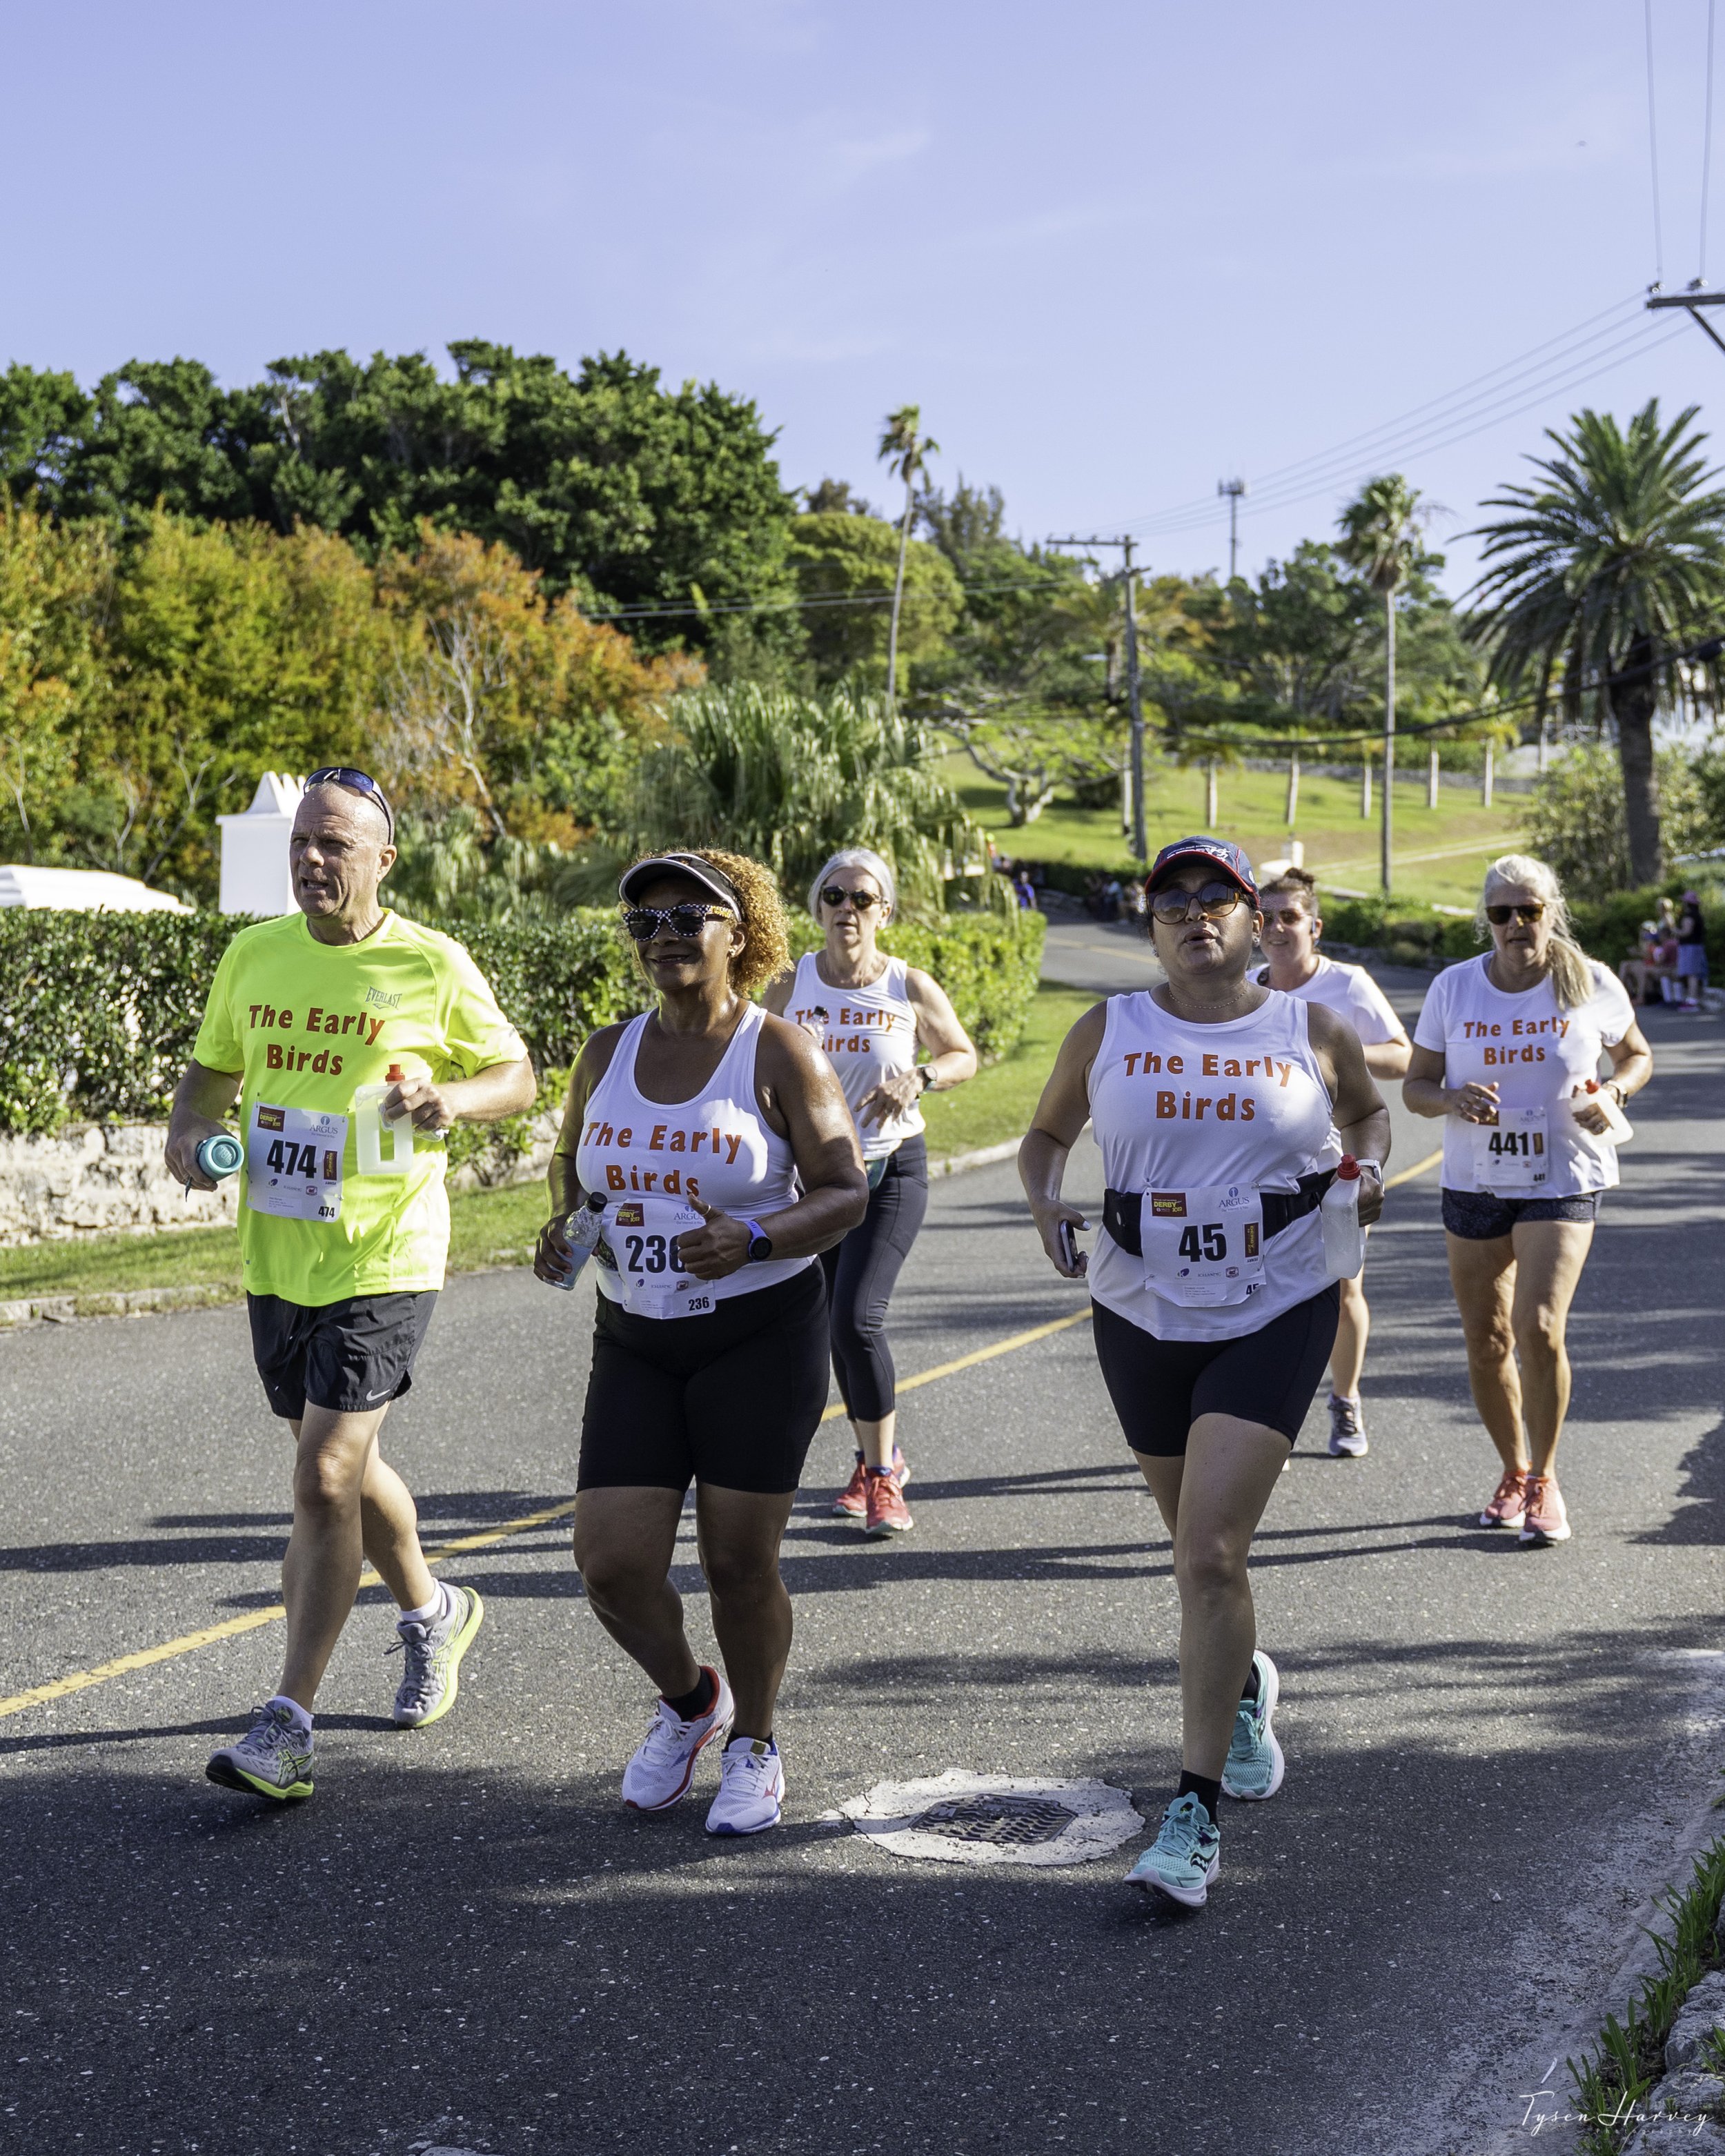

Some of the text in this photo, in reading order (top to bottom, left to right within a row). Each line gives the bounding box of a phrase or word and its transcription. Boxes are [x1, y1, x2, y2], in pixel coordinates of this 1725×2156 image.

[365, 986, 402, 1009] EVERLAST
[249, 1005, 385, 1046] The Early
[840, 1008, 895, 1032] Early
[1463, 1016, 1570, 1038] The Early
[822, 1034, 871, 1053] irds
[1484, 1045, 1546, 1065] Birds
[267, 1044, 343, 1076] Birds
[1123, 1051, 1292, 1087] The Early
[1156, 1091, 1255, 1122] Birds
[310, 1124, 339, 1134] ARGUS
[584, 1122, 742, 1165] The Early
[1488, 1131, 1529, 1156] 441
[266, 1139, 317, 1179] 474
[605, 1164, 700, 1197] Birds
[318, 1206, 335, 1218] 474
[1219, 1196, 1250, 1207] ARGUS
[1179, 1223, 1227, 1264] 45
[688, 1296, 710, 1312] 236
